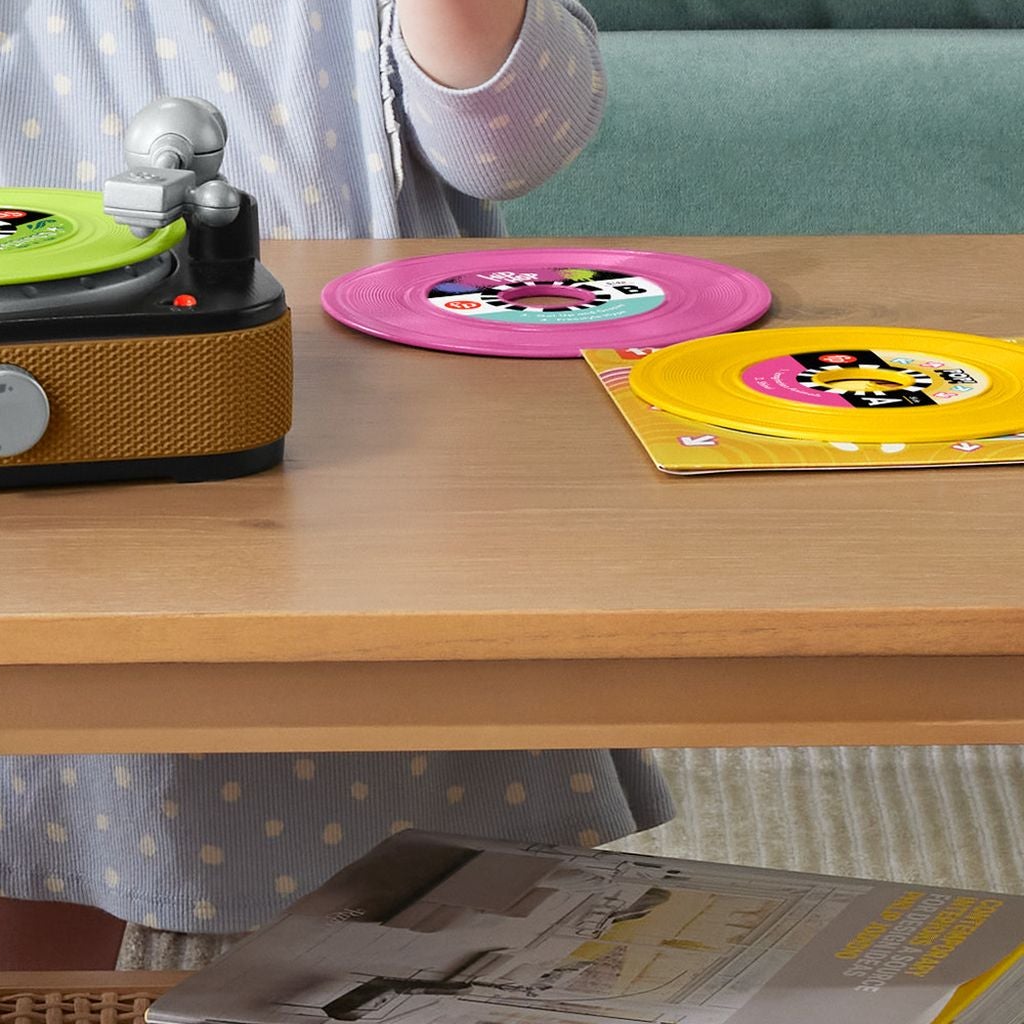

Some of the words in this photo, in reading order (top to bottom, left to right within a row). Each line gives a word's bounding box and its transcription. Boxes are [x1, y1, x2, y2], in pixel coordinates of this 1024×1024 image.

[613, 285, 648, 295] B
[861, 396, 903, 407] A
[915, 893, 951, 912] FOR
[877, 912, 928, 950] DESIGN
[901, 945, 923, 954] A
[843, 946, 891, 976] IDEAS
[854, 955, 915, 993] SOURCE
